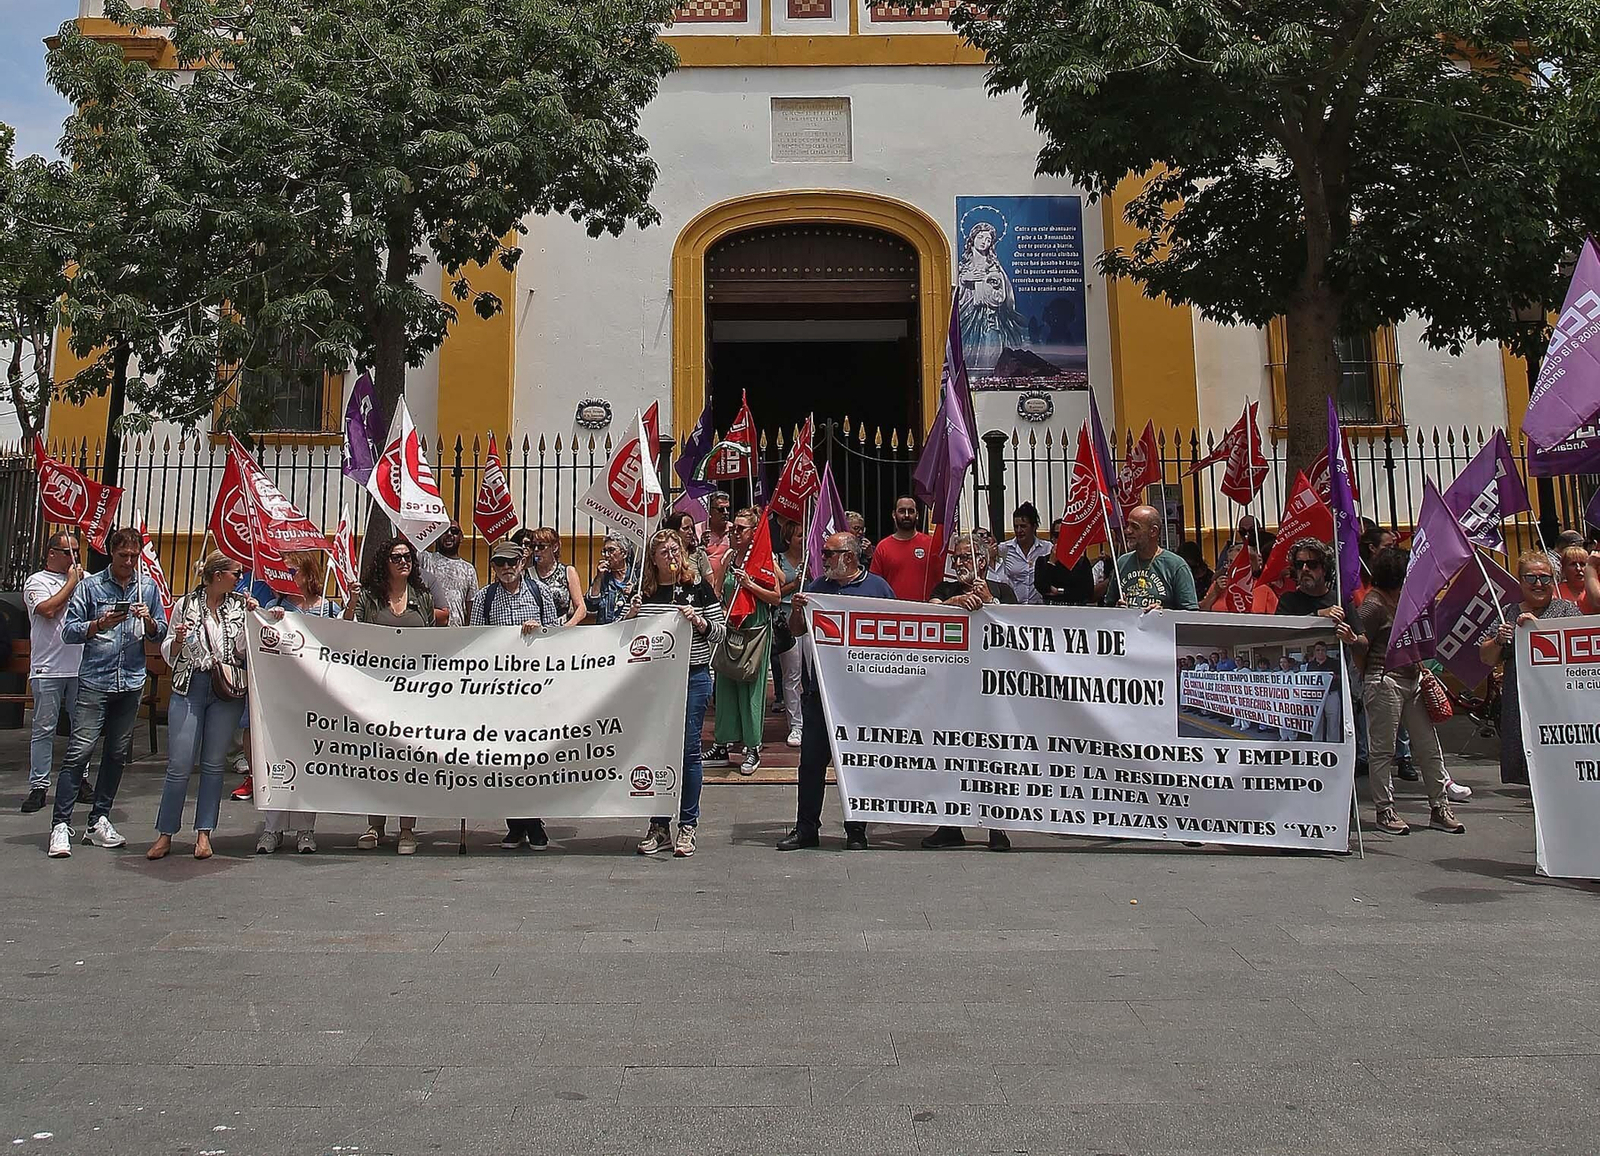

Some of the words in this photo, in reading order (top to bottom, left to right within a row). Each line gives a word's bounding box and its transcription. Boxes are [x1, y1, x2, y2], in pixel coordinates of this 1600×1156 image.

[1127, 570, 1149, 580] ROYAL
[982, 622, 1056, 652] ¡BASTA
[1063, 628, 1089, 654] YA
[1096, 630, 1125, 656] DE
[319, 647, 416, 670] Residencia
[422, 654, 489, 675] Tiempo
[494, 655, 540, 671] Libre
[546, 656, 565, 671] La
[571, 654, 615, 670] Línea
[847, 650, 903, 662] federación
[906, 652, 919, 662] de
[922, 653, 970, 664] servicios
[857, 664, 865, 673] la
[868, 664, 926, 676] ciudadanía
[982, 669, 1165, 705] DISCRIMINACION!
[1227, 674, 1248, 683] TIEMPO
[1250, 674, 1270, 684] LIBRE
[1271, 675, 1281, 684] DE
[1283, 675, 1292, 685] LA
[1295, 675, 1324, 686] LINEA
[1244, 685, 1252, 695] DE
[1254, 686, 1289, 700] SERVICIO
[1566, 682, 1572, 690] a
[1575, 680, 1584, 689] la
[1238, 697, 1272, 711] DERECHOS
[306, 712, 338, 730] Por
[344, 716, 360, 734] la
[366, 721, 466, 741] cobertura
[473, 725, 498, 741] de
[504, 724, 592, 742] vacantes
[597, 718, 623, 735] YA
[1268, 714, 1282, 727] DEL
[313, 739, 324, 755] y
[330, 741, 437, 763] ampliación
[445, 748, 470, 765] de
[476, 749, 549, 770] tiempo
[556, 749, 580, 762] en
[585, 743, 615, 759] los
[857, 726, 924, 745] LINEA
[932, 730, 1039, 750] NECESITA
[1047, 736, 1203, 762] INVERSIONES
[1214, 748, 1229, 764] Y
[1239, 749, 1338, 768] EMPLEO
[305, 762, 399, 782] contratos
[405, 768, 428, 785] de
[435, 770, 478, 790] fijos
[484, 768, 623, 787] discontinuos.
[842, 753, 937, 770] REFORMA
[944, 758, 1042, 777] INTEGRAL
[1049, 764, 1076, 779] DE
[1083, 766, 1107, 781] LA
[1114, 769, 1234, 790] RESIDENCIA
[1242, 777, 1324, 792] TIEMPO
[960, 778, 1020, 796] LIBRE
[1027, 783, 1053, 797] DE
[1060, 785, 1084, 800] LA
[1091, 787, 1149, 804] LINEA
[1157, 792, 1190, 807] YA!
[945, 802, 971, 816] DE
[978, 804, 1043, 821] TODAS
[1050, 809, 1085, 824] LAS
[1092, 811, 1168, 829] PLAZAS
[1175, 817, 1276, 835] VACANTES
